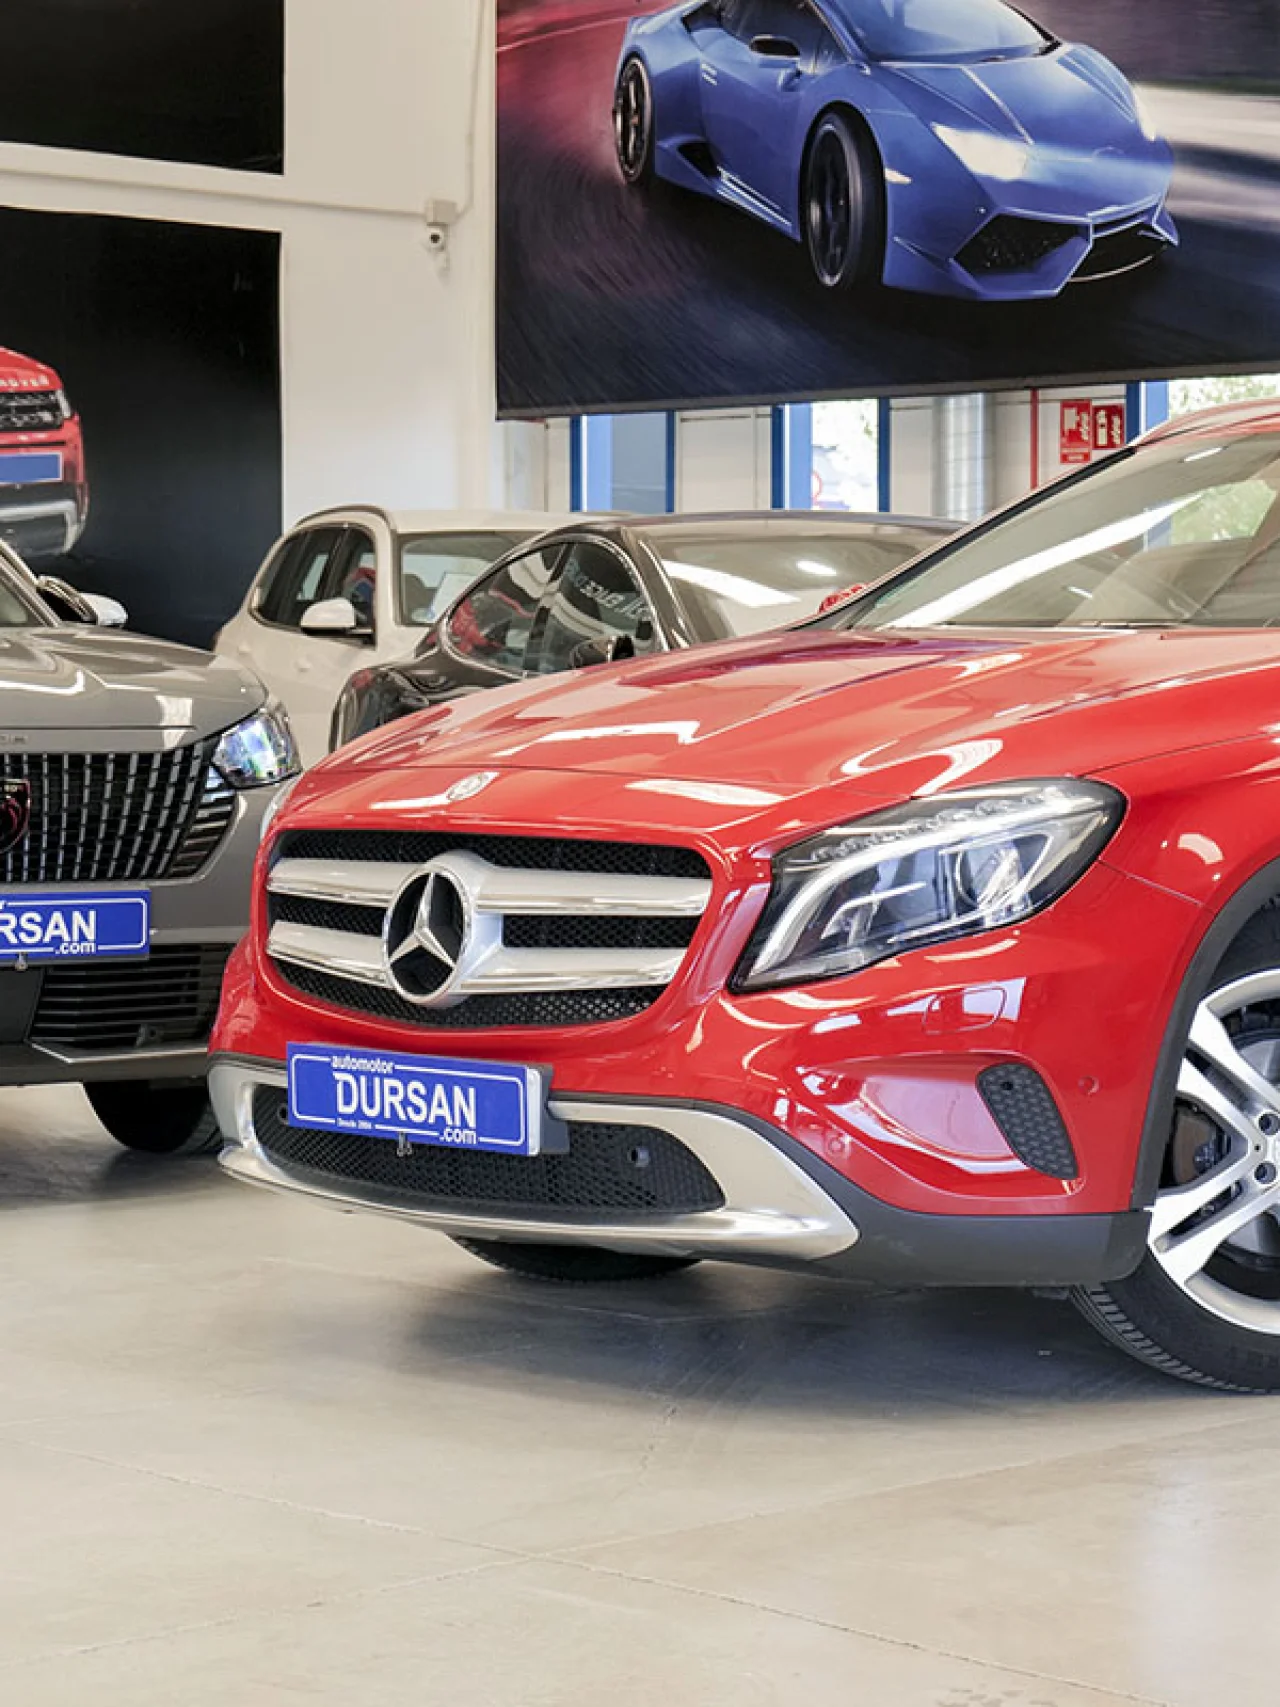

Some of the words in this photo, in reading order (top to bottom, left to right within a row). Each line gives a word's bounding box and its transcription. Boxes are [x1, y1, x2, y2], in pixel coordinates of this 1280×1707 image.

[55, 942, 96, 955] .com
[332, 1054, 394, 1074] automotor
[333, 1071, 477, 1128] DURSAN
[439, 1127, 477, 1145] .com
